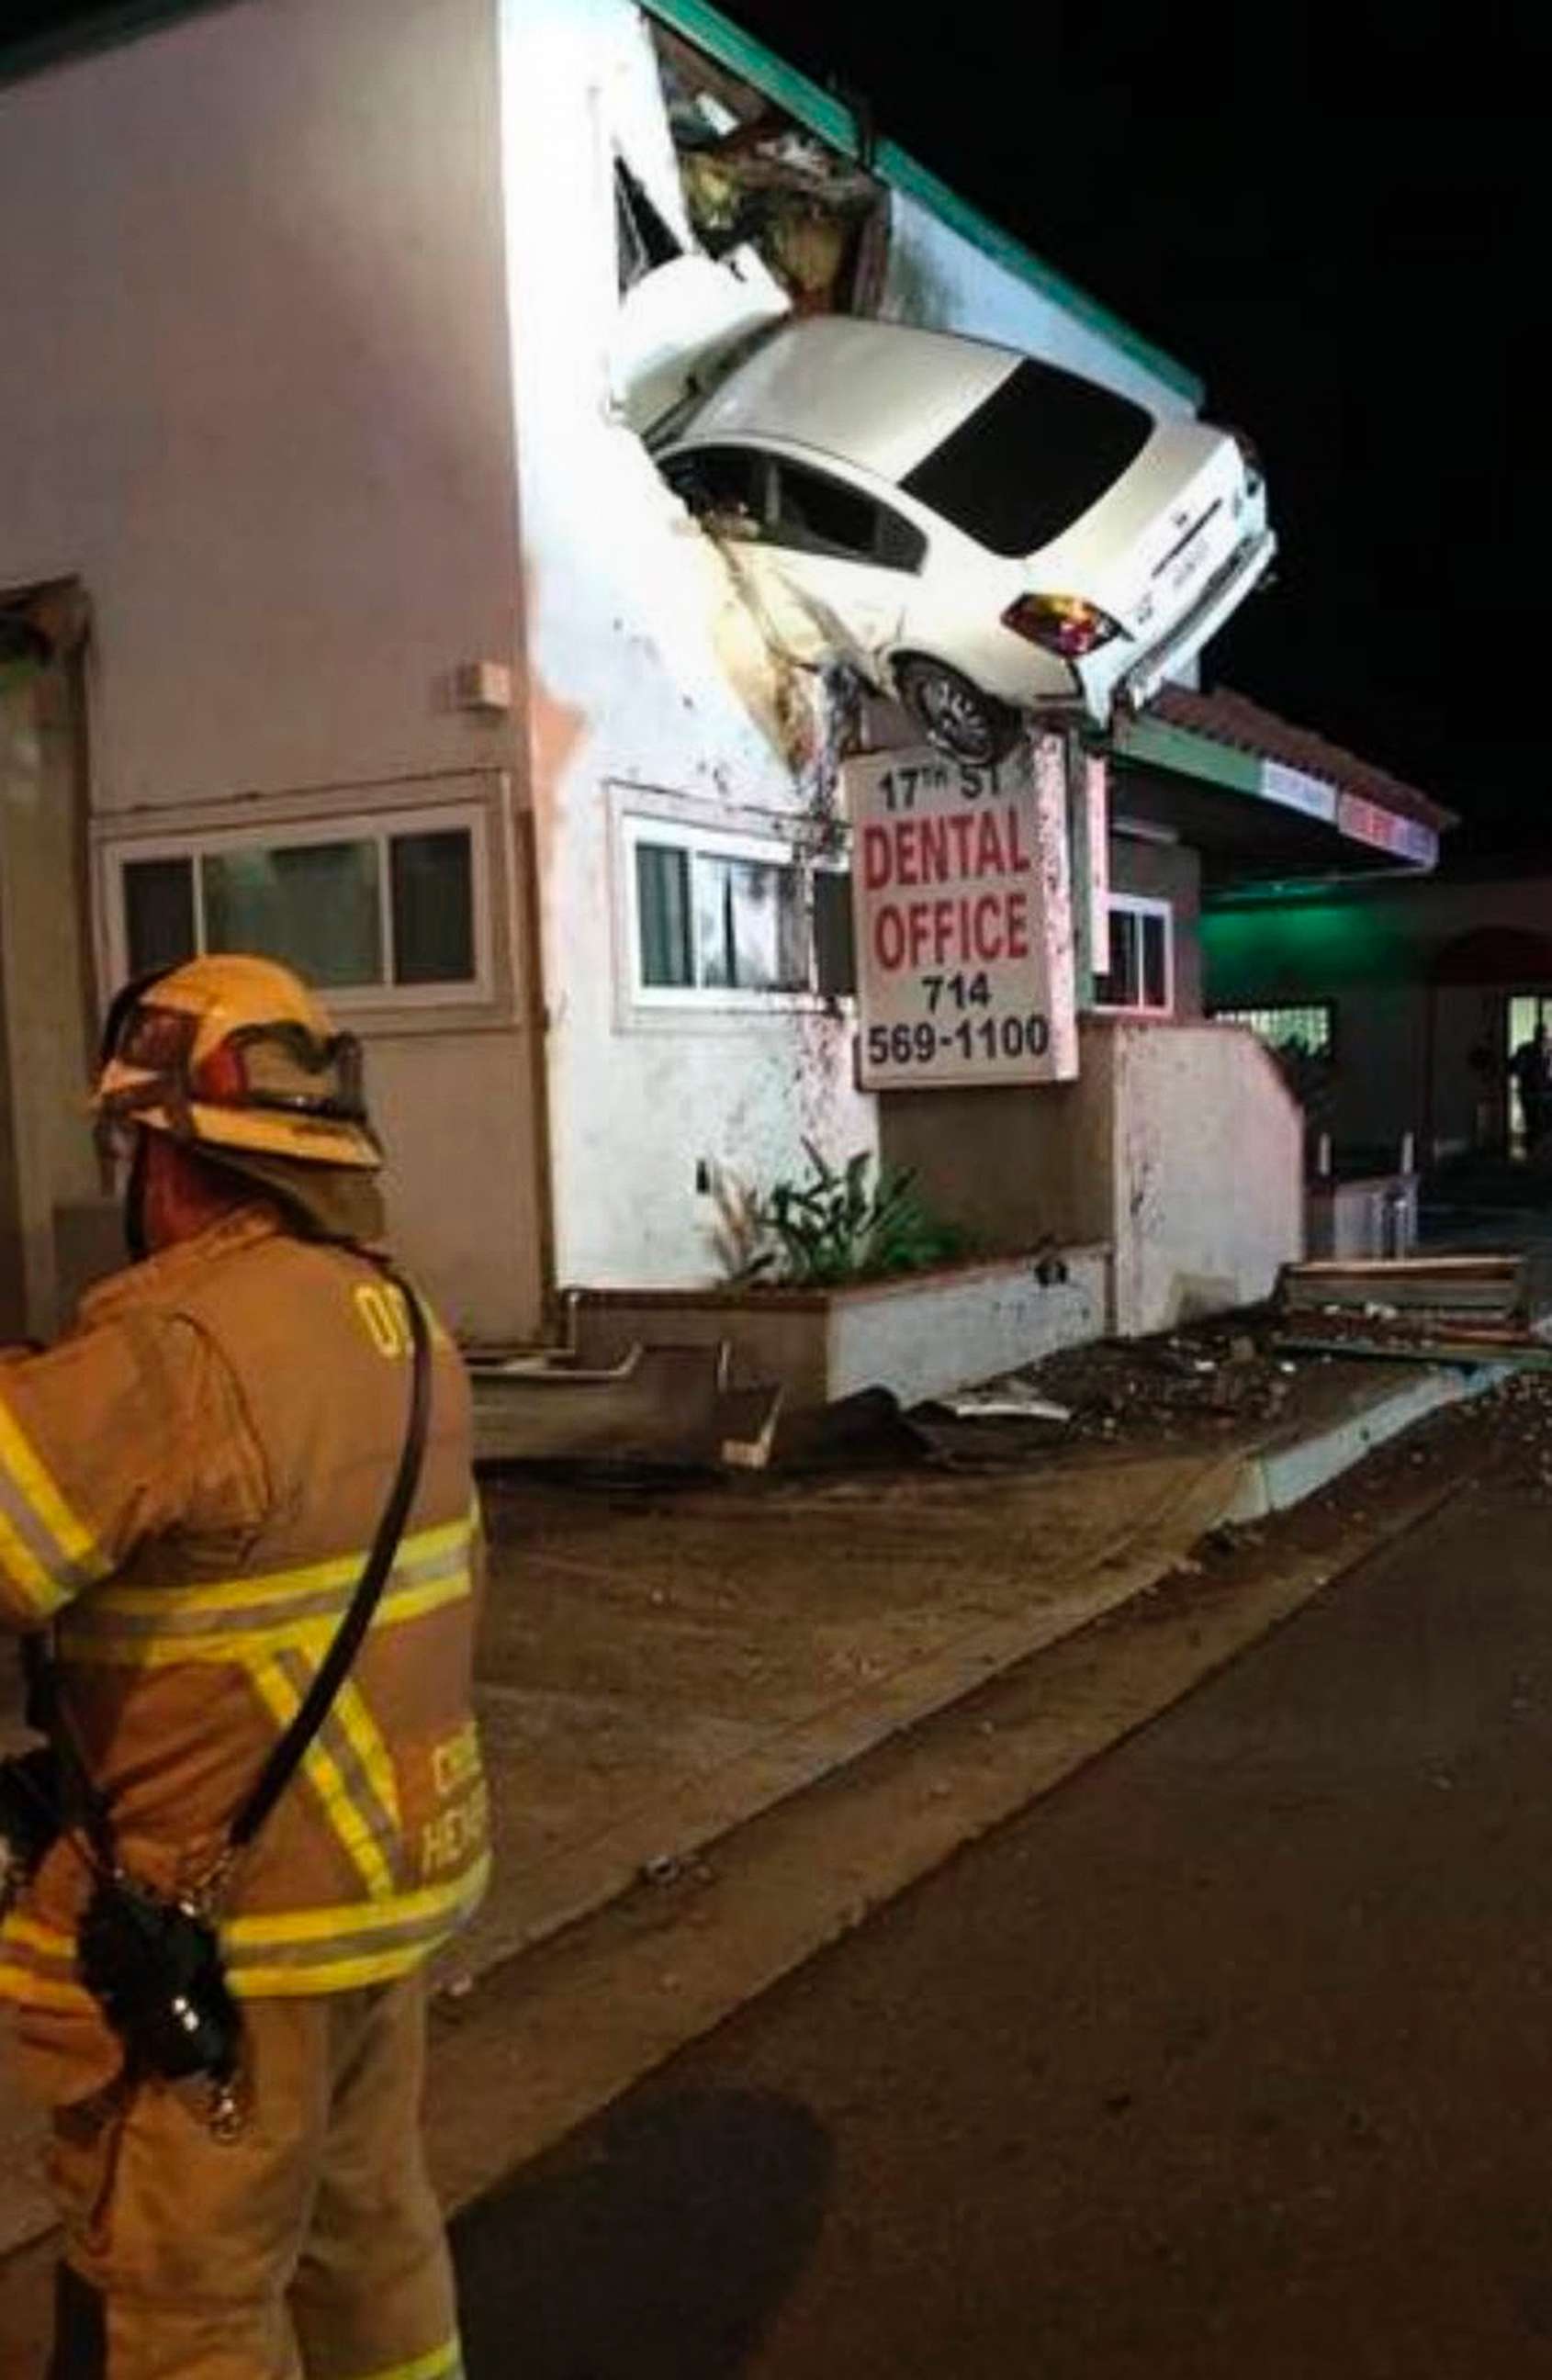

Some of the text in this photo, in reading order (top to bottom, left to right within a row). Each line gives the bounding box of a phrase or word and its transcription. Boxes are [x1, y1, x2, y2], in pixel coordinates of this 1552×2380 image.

[862, 805, 1031, 890] DENTAL
[873, 892, 1029, 971] OFFICE
[922, 971, 992, 1014] 714
[868, 1014, 1049, 1064] 569-1100
